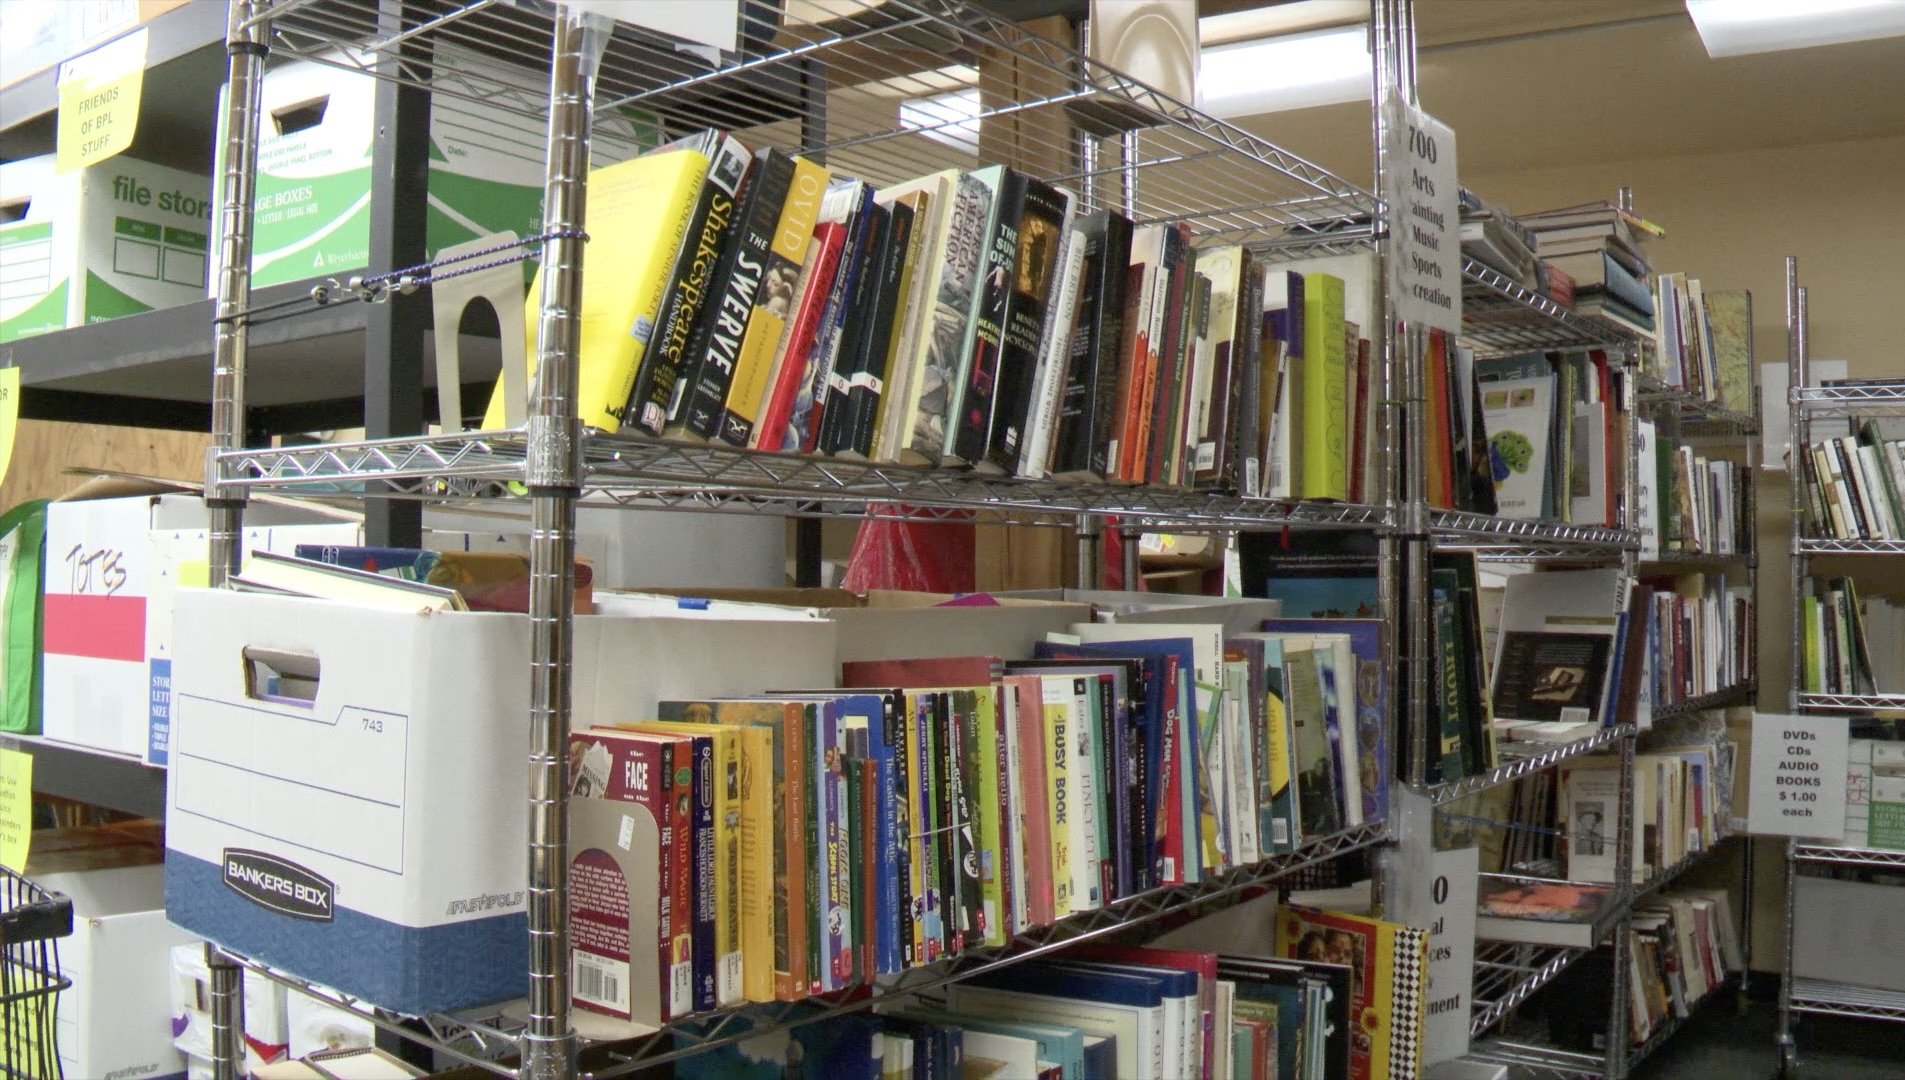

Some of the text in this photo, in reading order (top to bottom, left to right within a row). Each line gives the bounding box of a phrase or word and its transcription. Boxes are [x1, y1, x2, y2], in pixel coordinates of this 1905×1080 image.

[78, 87, 118, 115] FRIENDS
[81, 111, 113, 134] OF BPL
[81, 134, 110, 157] STUFF
[1409, 126, 1437, 164] 700
[112, 175, 151, 206] file
[275, 185, 313, 207] BOXES
[1412, 168, 1435, 197] Arts
[782, 174, 819, 252] OVID
[749, 231, 768, 250] THE
[944, 192, 968, 267] FICTION
[953, 189, 979, 283] AMERICAN
[966, 210, 987, 275] NORTH
[1000, 223, 1017, 242] THE
[1413, 225, 1440, 252] Music
[666, 193, 732, 364] Shakespeare
[1412, 252, 1442, 280] Sports
[1062, 246, 1082, 320] BILL BRYSON
[1414, 283, 1452, 311] creation
[659, 291, 684, 357] HANDBOOK
[706, 251, 764, 376] SWERVE
[1174, 305, 1189, 381] Mountain World
[1046, 336, 1062, 395] TROUBLESOME
[1040, 397, 1052, 430] WORDS
[66, 543, 127, 600] TOTES
[151, 705, 168, 717] SIZE
[362, 718, 383, 733] 743
[968, 711, 976, 737] Tolan
[1076, 699, 1086, 729] Estes
[897, 715, 905, 776] SURVIVOR
[998, 734, 1007, 764] after
[1162, 708, 1175, 762] DOG MAN
[1783, 731, 1816, 740] DVDs
[1779, 761, 1819, 771] AUDIO
[1787, 746, 1811, 756] CDs
[582, 763, 605, 791] MISSING
[625, 761, 648, 791] FACE
[920, 750, 928, 792] SPINELLI
[942, 755, 950, 780] Dead
[1053, 723, 1067, 825] BUSY BOOK
[1776, 776, 1821, 787] BOOKS
[636, 794, 650, 802] the
[942, 782, 951, 802] Dog
[1000, 778, 1008, 805] hello
[1779, 791, 1817, 802] $ 1.00
[791, 780, 799, 841] The Last Battle
[884, 757, 896, 864] The Castle in the Attic
[1080, 773, 1096, 870] PINKY PYE
[1782, 807, 1813, 817] each
[661, 827, 670, 845] FACE
[837, 828, 848, 874] ROOM
[677, 825, 689, 908] WILD MAGIC
[828, 841, 838, 874] SCHOOL
[228, 860, 328, 910] BANKERS BOX
[697, 827, 708, 922] FRANCES HODGSON BURNETT
[706, 826, 716, 920] LITTLE LORD FAUNTLEROY
[661, 896, 670, 914] MILK
[829, 876, 838, 904] STORY
[839, 879, 850, 910] ONE
[660, 916, 669, 938] CARTON
